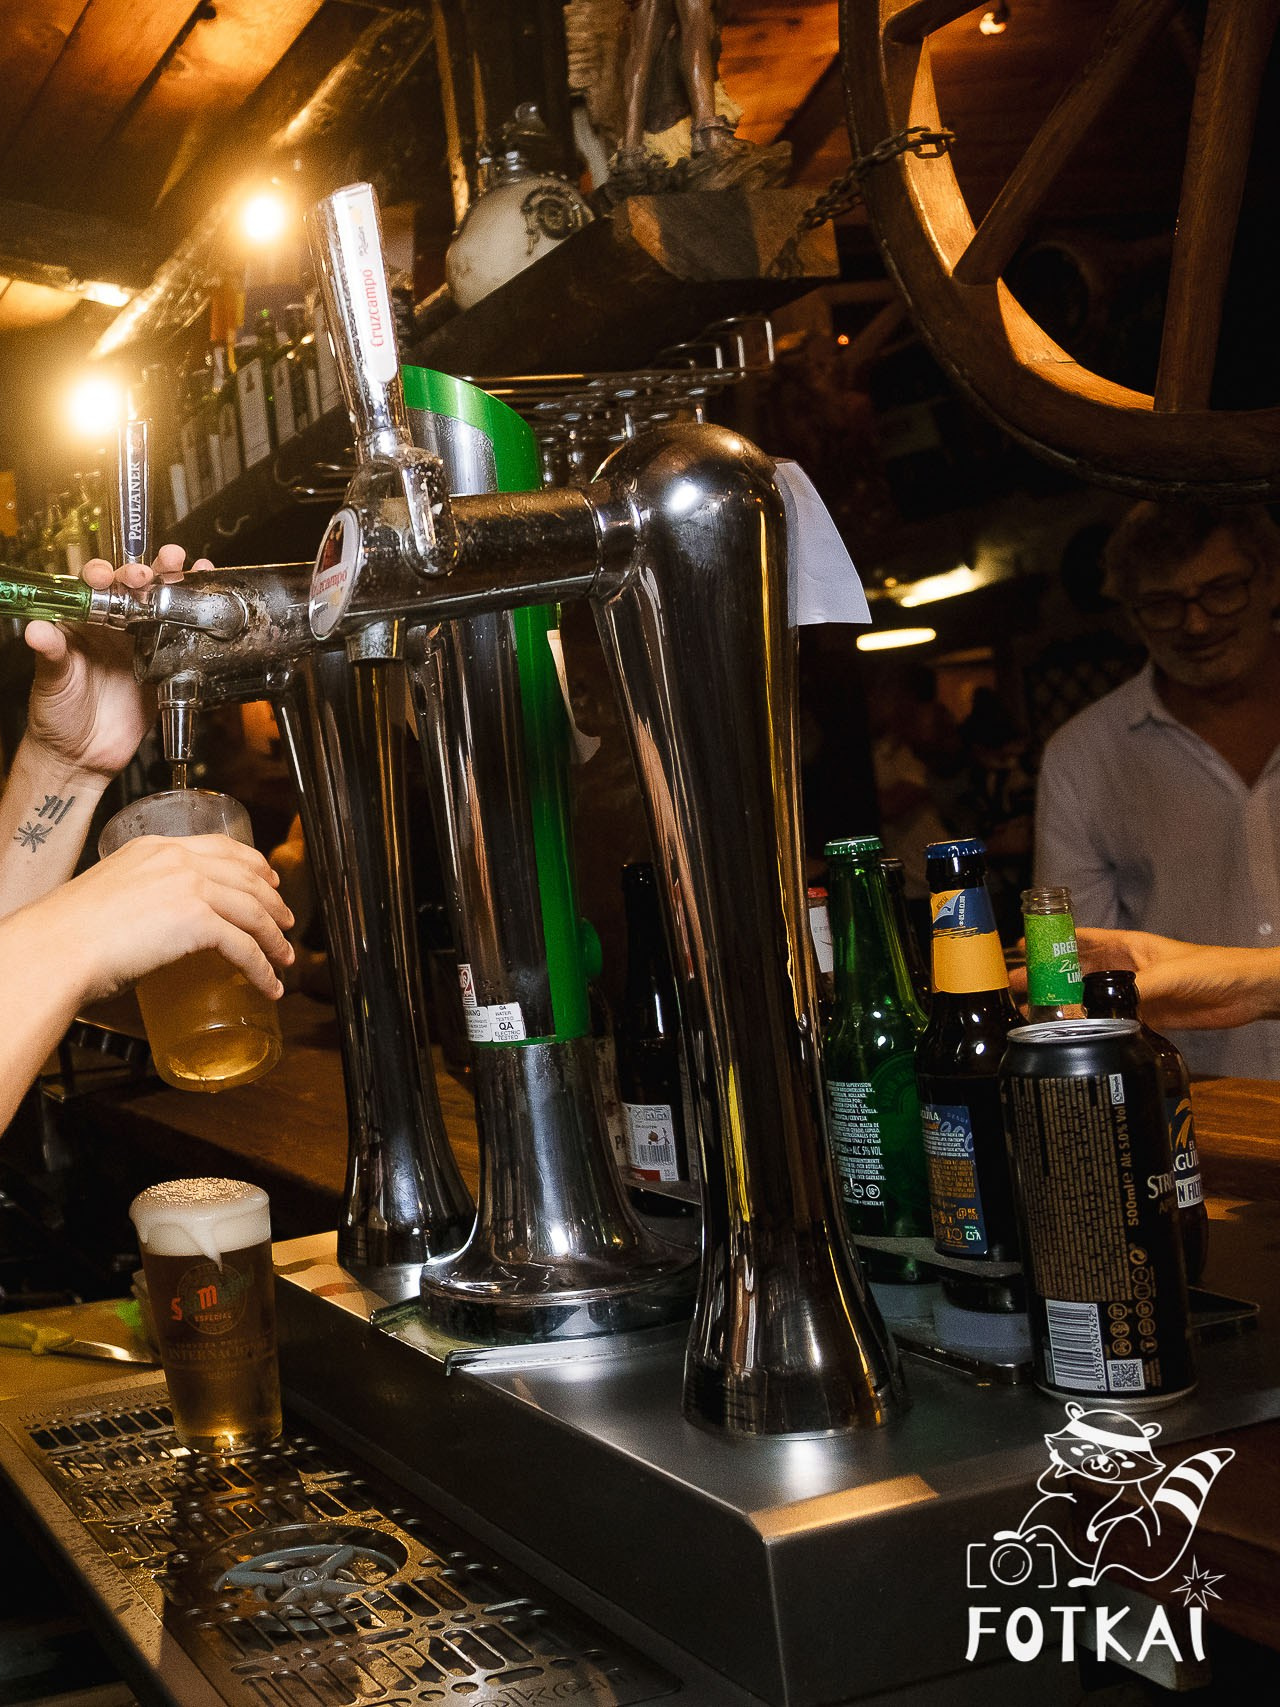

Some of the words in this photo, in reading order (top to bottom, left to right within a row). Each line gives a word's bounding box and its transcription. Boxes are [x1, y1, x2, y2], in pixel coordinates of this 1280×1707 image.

[361, 268, 385, 347] Cruzcampo
[127, 461, 142, 541] PAULANER
[494, 1029, 521, 1037] ELECTRIC
[498, 1021, 515, 1031] QA
[1114, 1105, 1127, 1122] Vol
[1117, 1123, 1130, 1150] 5.0%
[1120, 1151, 1133, 1168] Alc
[193, 1312, 232, 1323] ESPECIAL
